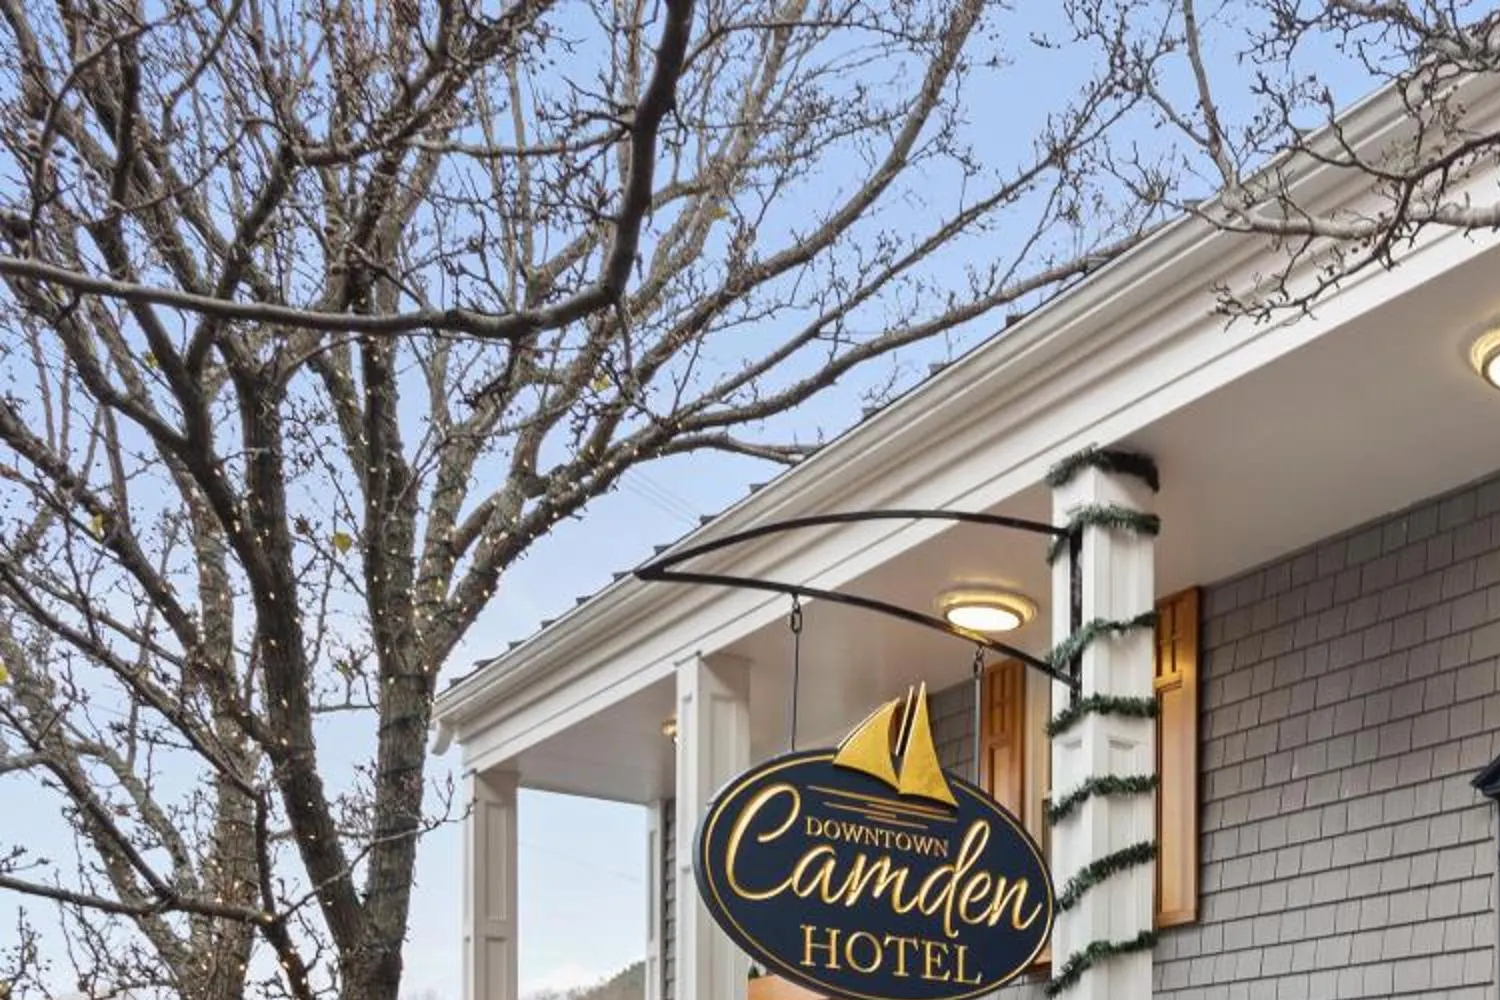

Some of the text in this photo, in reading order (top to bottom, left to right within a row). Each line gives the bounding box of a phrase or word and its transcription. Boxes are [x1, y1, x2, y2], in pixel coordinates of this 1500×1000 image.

[725, 783, 1043, 938] Camden
[804, 815, 949, 857] DOWNTOWN
[799, 924, 984, 985] HOTEL
